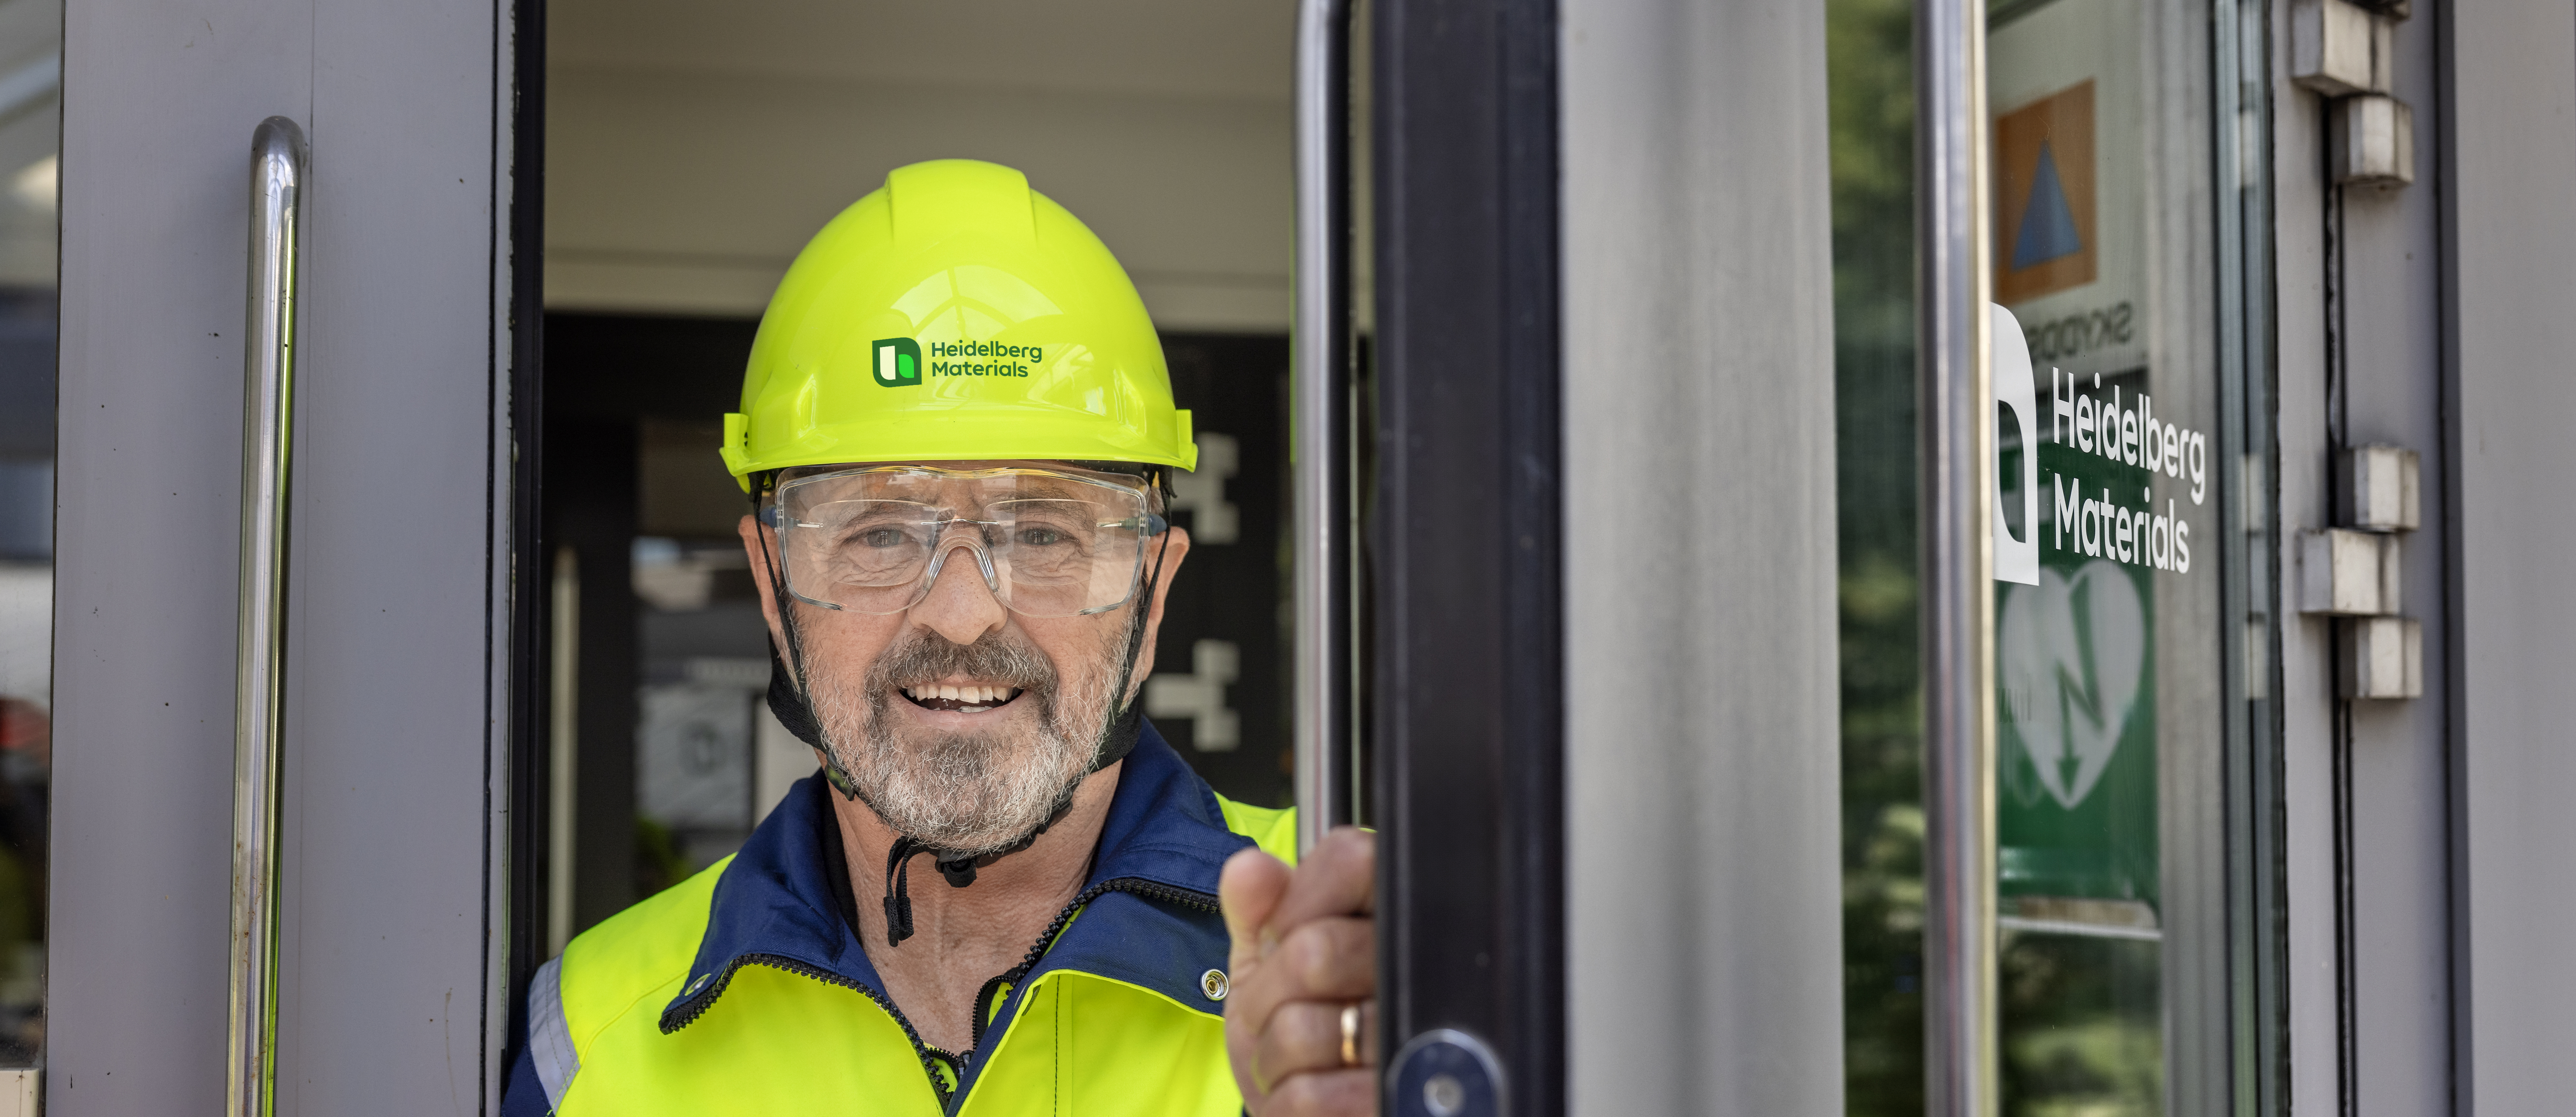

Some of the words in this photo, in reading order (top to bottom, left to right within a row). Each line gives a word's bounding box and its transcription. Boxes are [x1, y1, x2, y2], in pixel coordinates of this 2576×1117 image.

[932, 340, 1042, 363] Heidelberg
[932, 359, 1028, 377] Materials
[2053, 366, 2205, 505] Heidelberg
[2055, 473, 2190, 574] Materials
